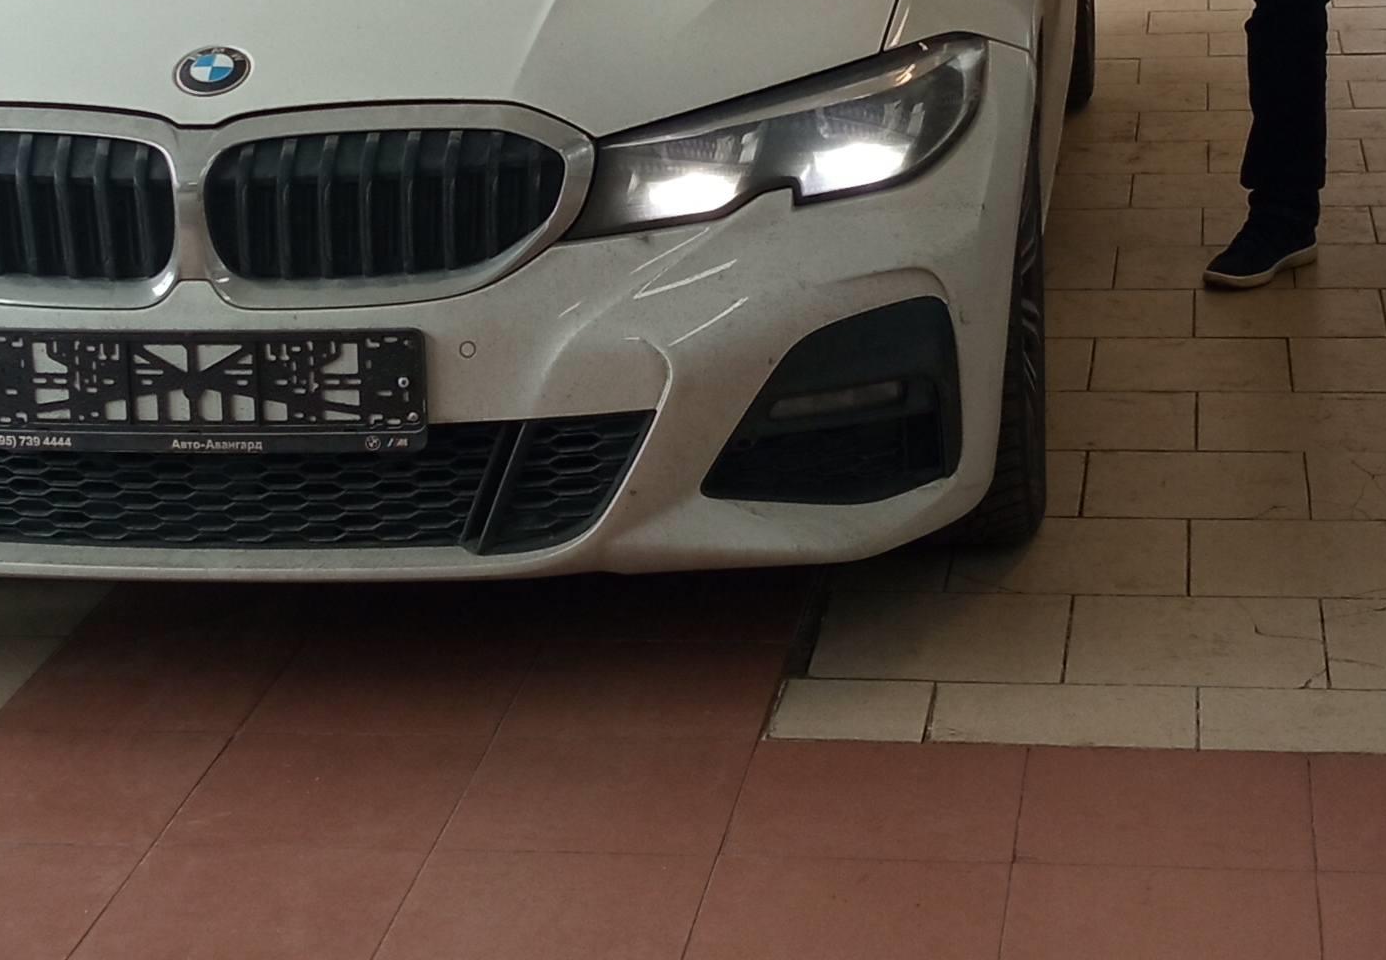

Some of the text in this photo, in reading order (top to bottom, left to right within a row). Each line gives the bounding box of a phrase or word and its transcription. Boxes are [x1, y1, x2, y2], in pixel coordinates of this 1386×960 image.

[19, 435, 41, 447] 739
[43, 436, 72, 448] 4444
[171, 438, 263, 453] Авто-Авангард
